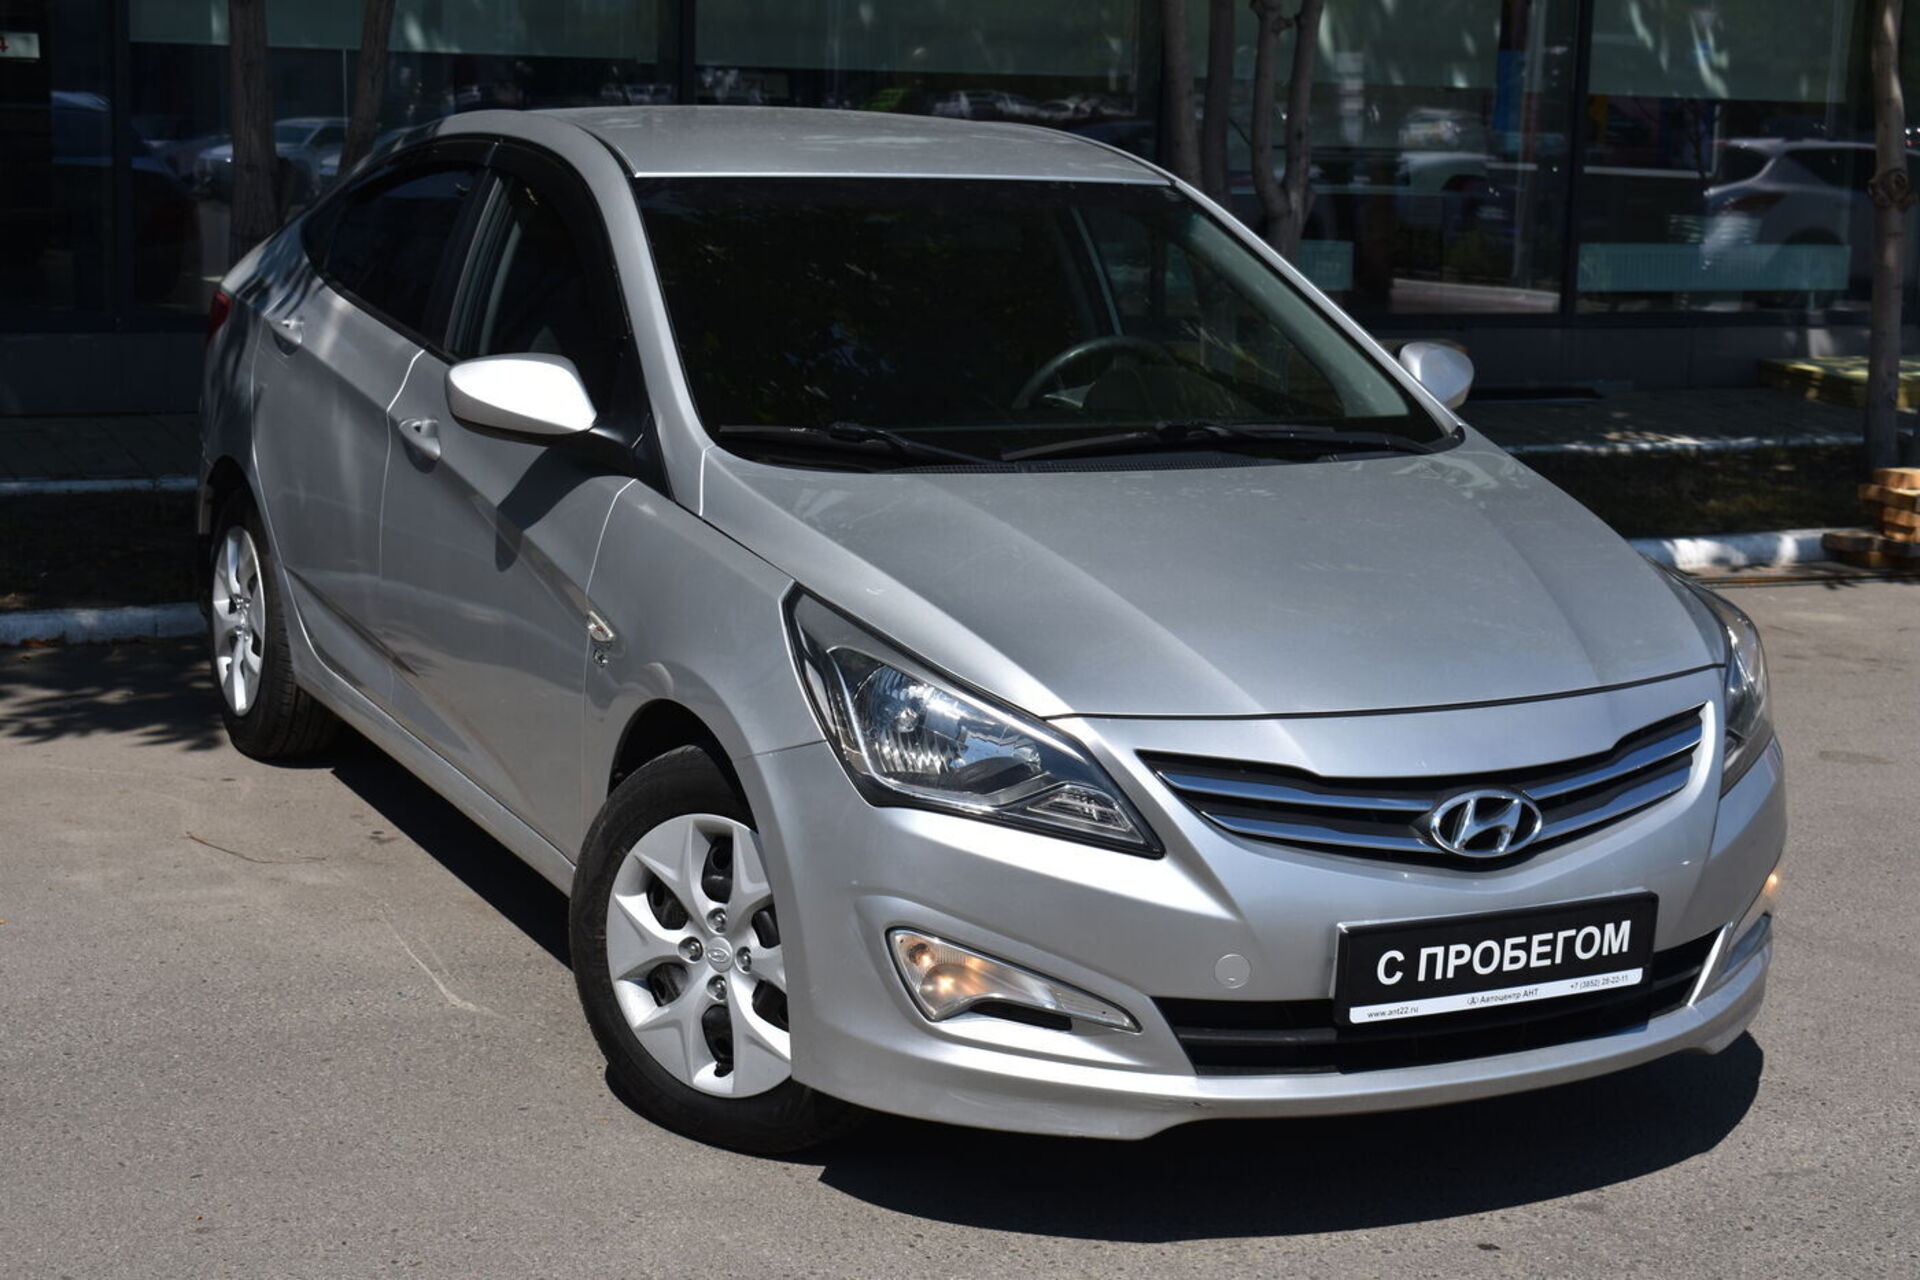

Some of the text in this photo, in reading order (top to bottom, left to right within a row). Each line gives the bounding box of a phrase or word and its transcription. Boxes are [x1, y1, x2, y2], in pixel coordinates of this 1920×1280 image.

[1377, 920, 1631, 985] С ПРОБЕГОМ
[1480, 988, 1539, 1003] Автоцентр АНТ
[1367, 1006, 1419, 1018] www.ant22.ru
